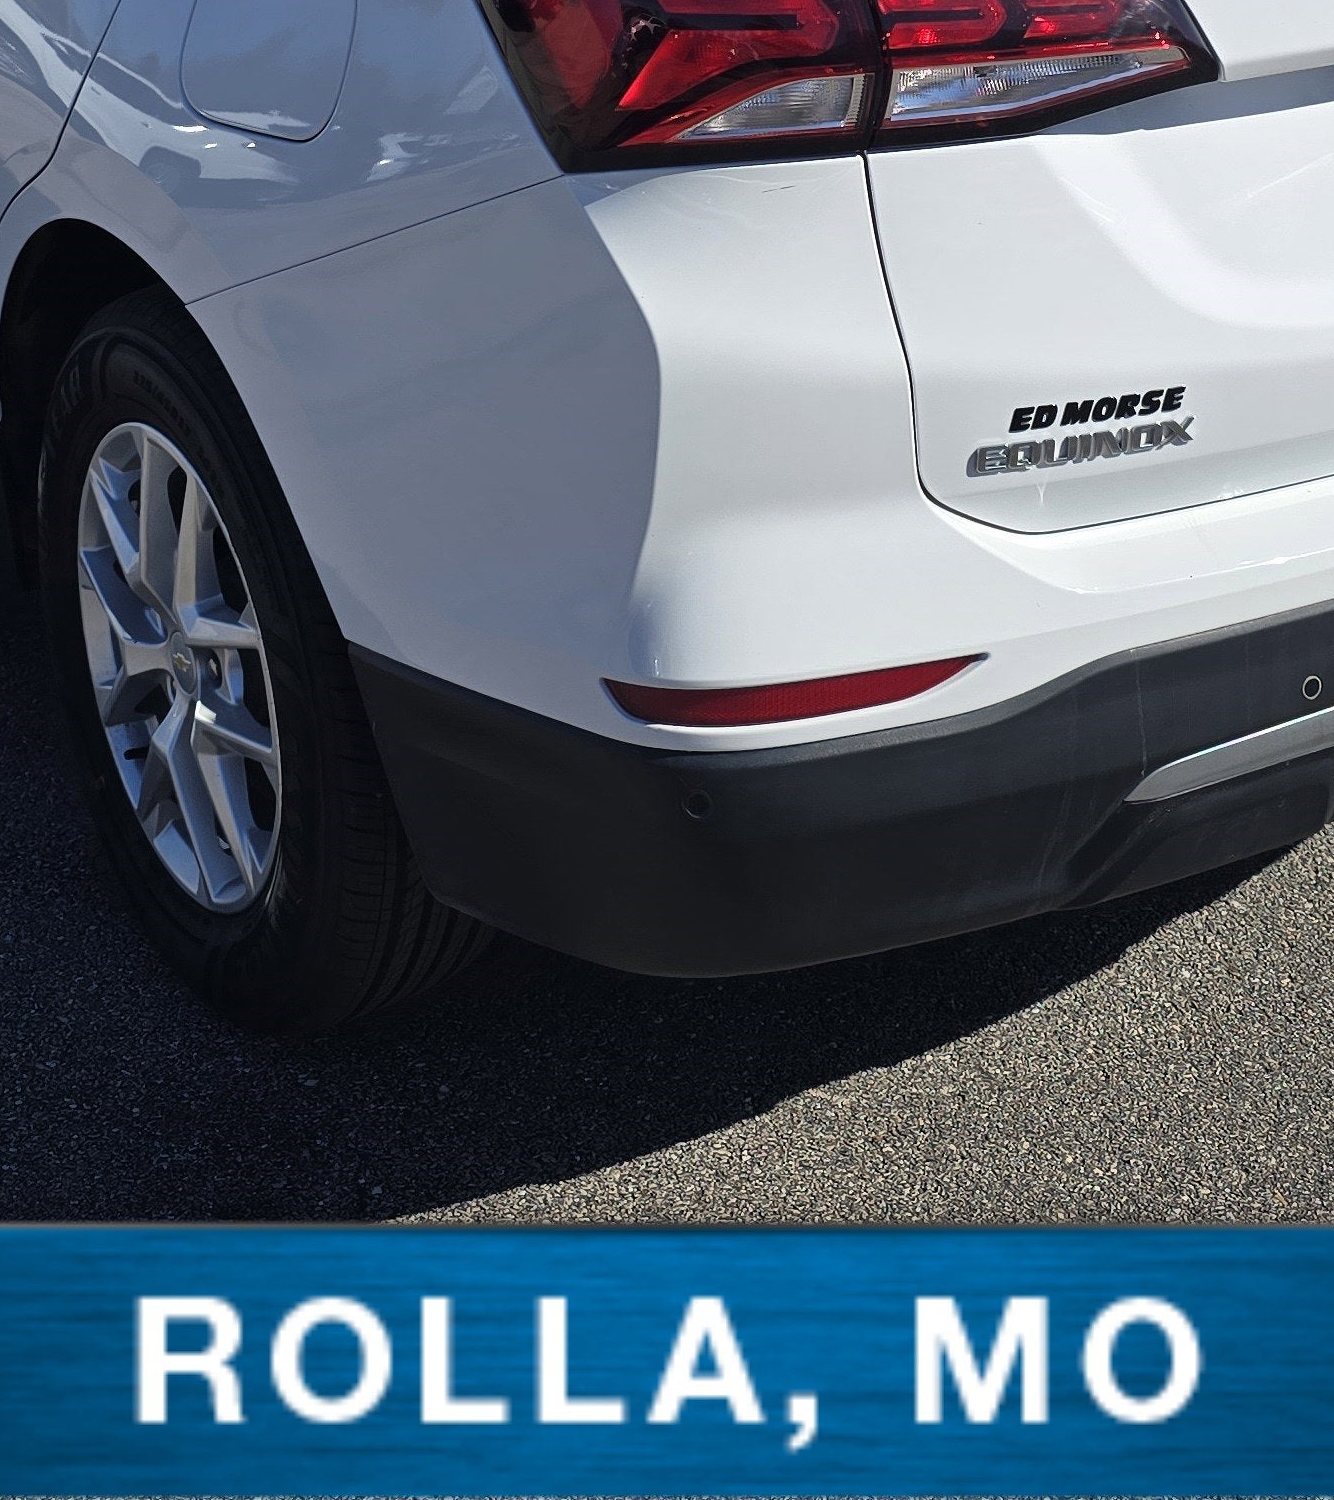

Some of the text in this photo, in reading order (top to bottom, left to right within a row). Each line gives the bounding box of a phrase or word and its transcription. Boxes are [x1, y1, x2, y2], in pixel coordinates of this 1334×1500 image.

[1008, 386, 1187, 433] ED MORSE
[966, 415, 1194, 477] EQUINOX
